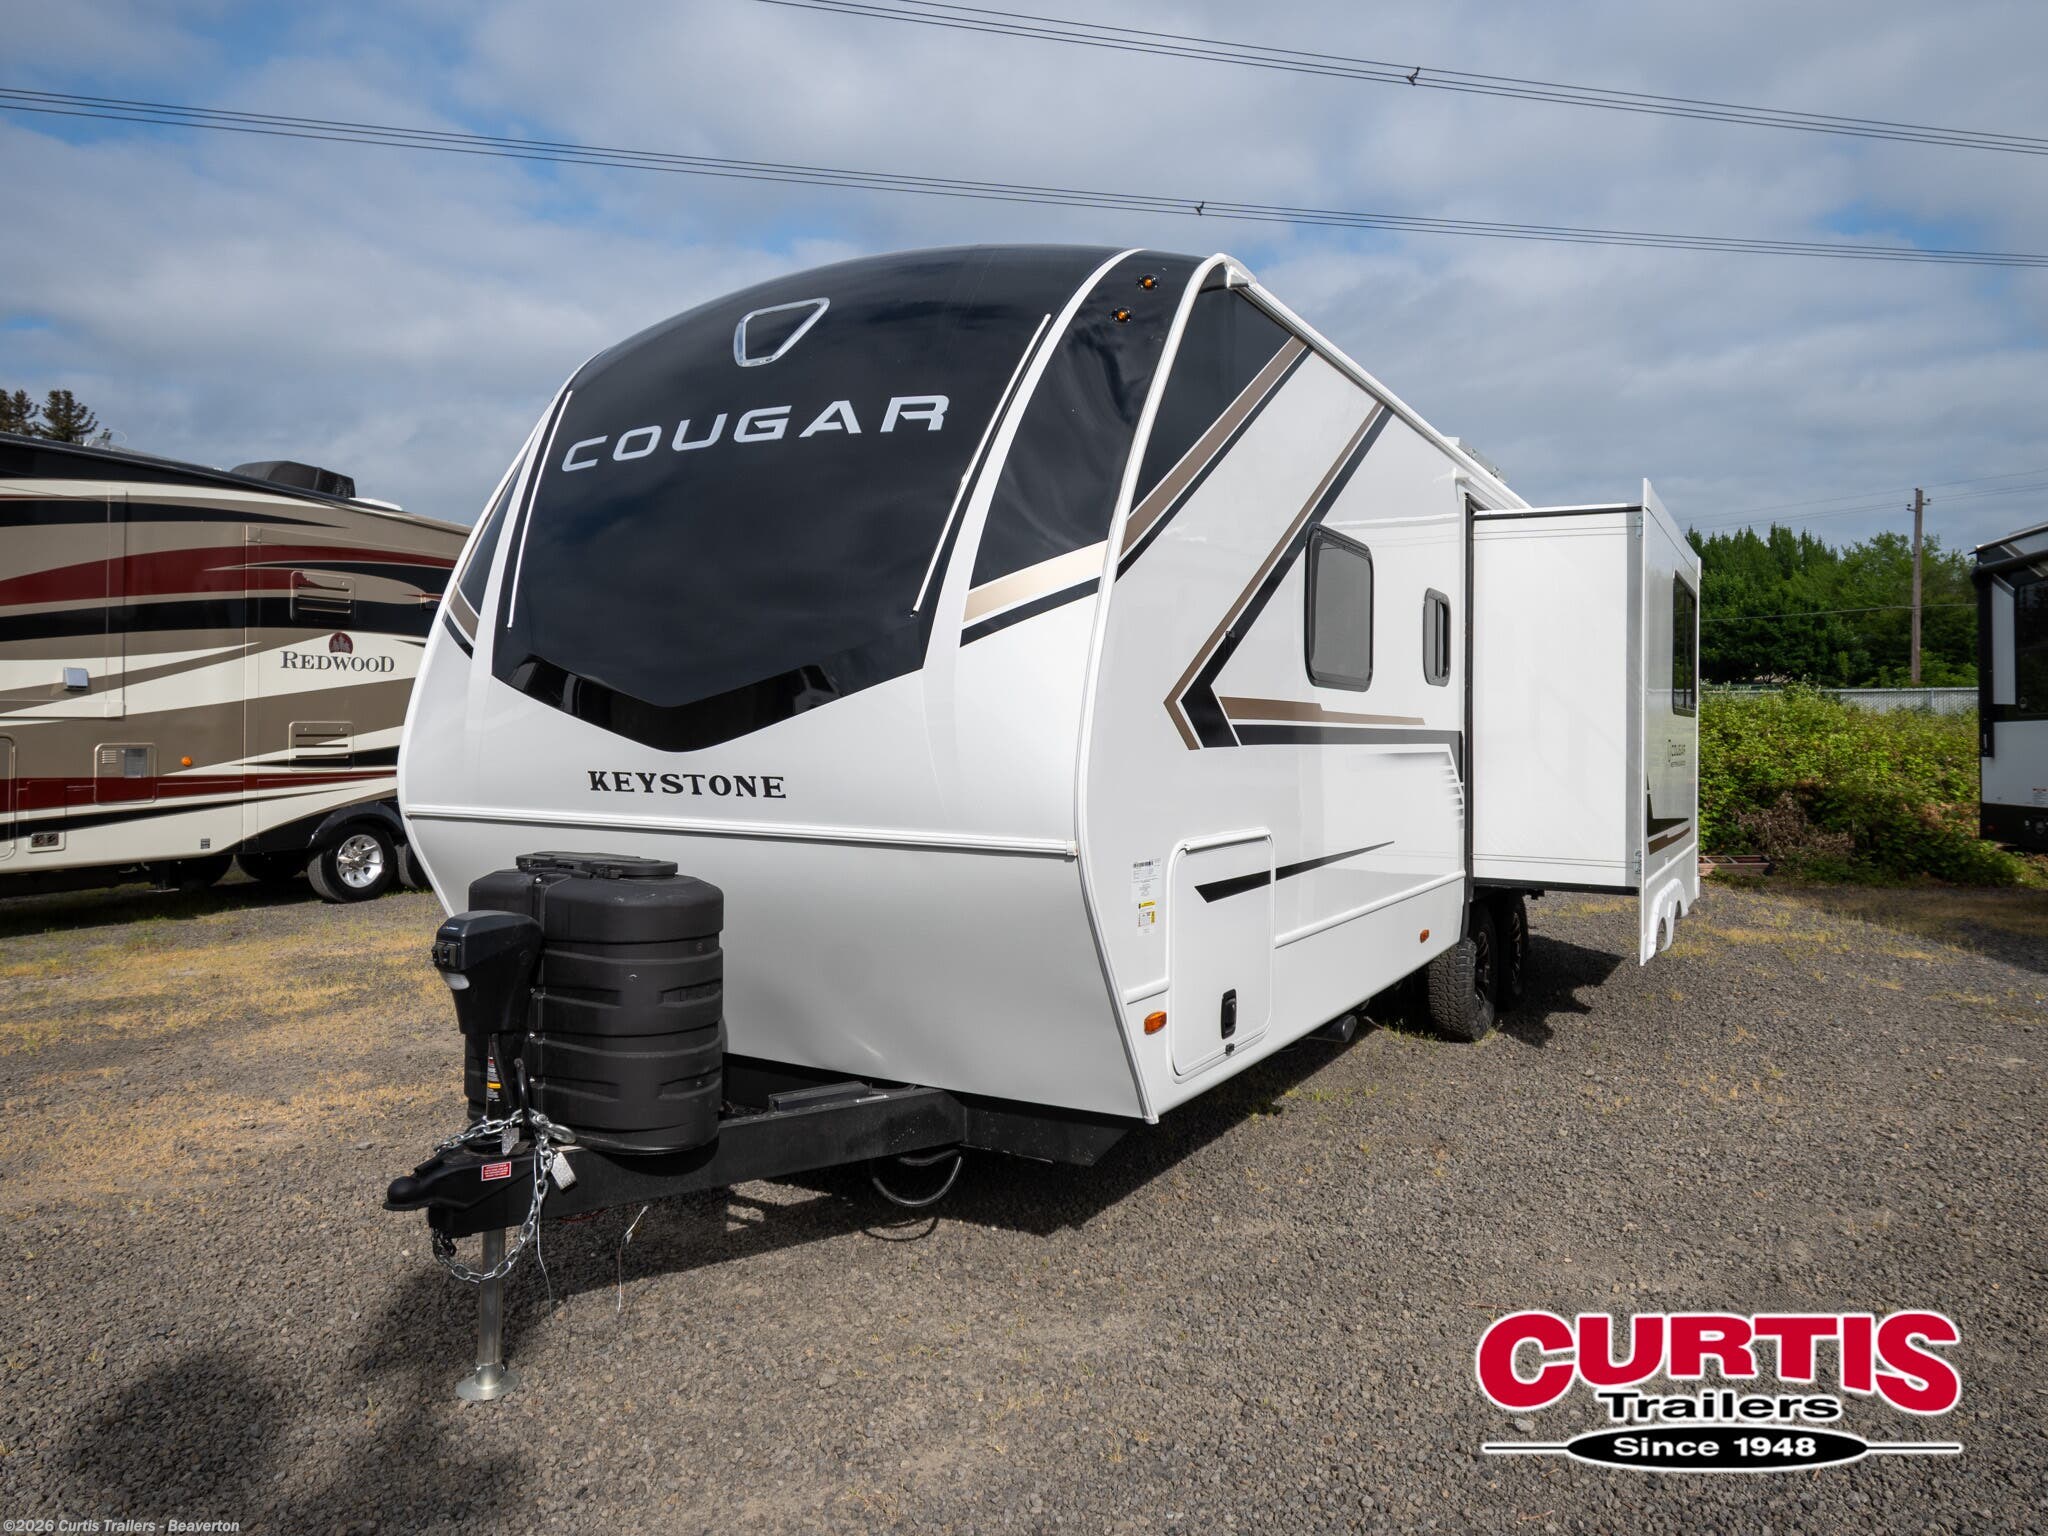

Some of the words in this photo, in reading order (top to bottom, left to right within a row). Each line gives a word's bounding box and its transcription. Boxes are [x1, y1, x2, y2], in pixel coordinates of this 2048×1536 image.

[562, 394, 950, 472] COUGAR
[280, 651, 395, 673] REDWOOD
[587, 771, 787, 799] KEYSTONE
